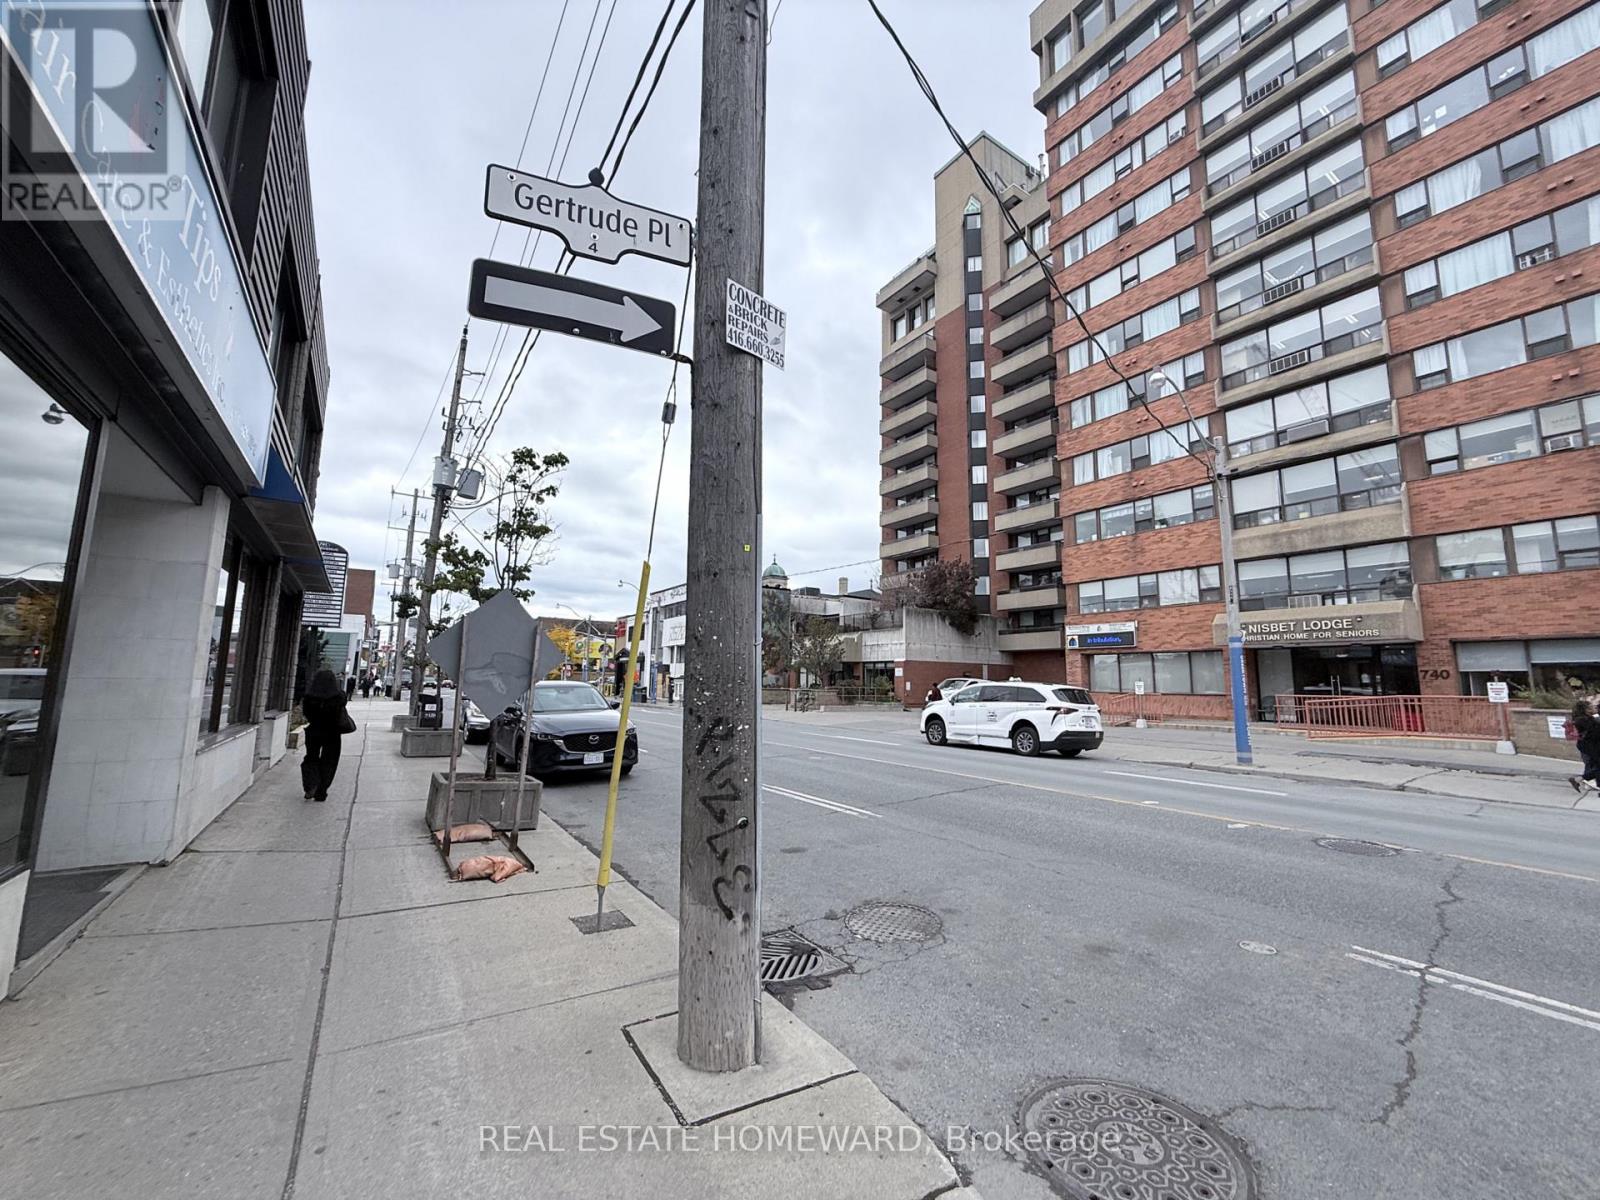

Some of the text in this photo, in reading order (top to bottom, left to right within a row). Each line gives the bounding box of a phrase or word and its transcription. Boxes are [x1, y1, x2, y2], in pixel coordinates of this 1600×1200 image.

[514, 183, 672, 248] Gertrude Pl
[138, 217, 152, 269] &
[179, 175, 222, 301] Tips
[588, 242, 598, 253] 4
[729, 283, 785, 329] CONCRETE
[728, 314, 769, 344] REPAIRS
[727, 328, 785, 368] 416.660.3255
[1248, 618, 1353, 633] NISBET LODGE
[1283, 632, 1309, 640] HOME
[1313, 631, 1332, 639] FOR
[1335, 629, 1380, 638] SENIORS
[1420, 669, 1450, 681] 740
